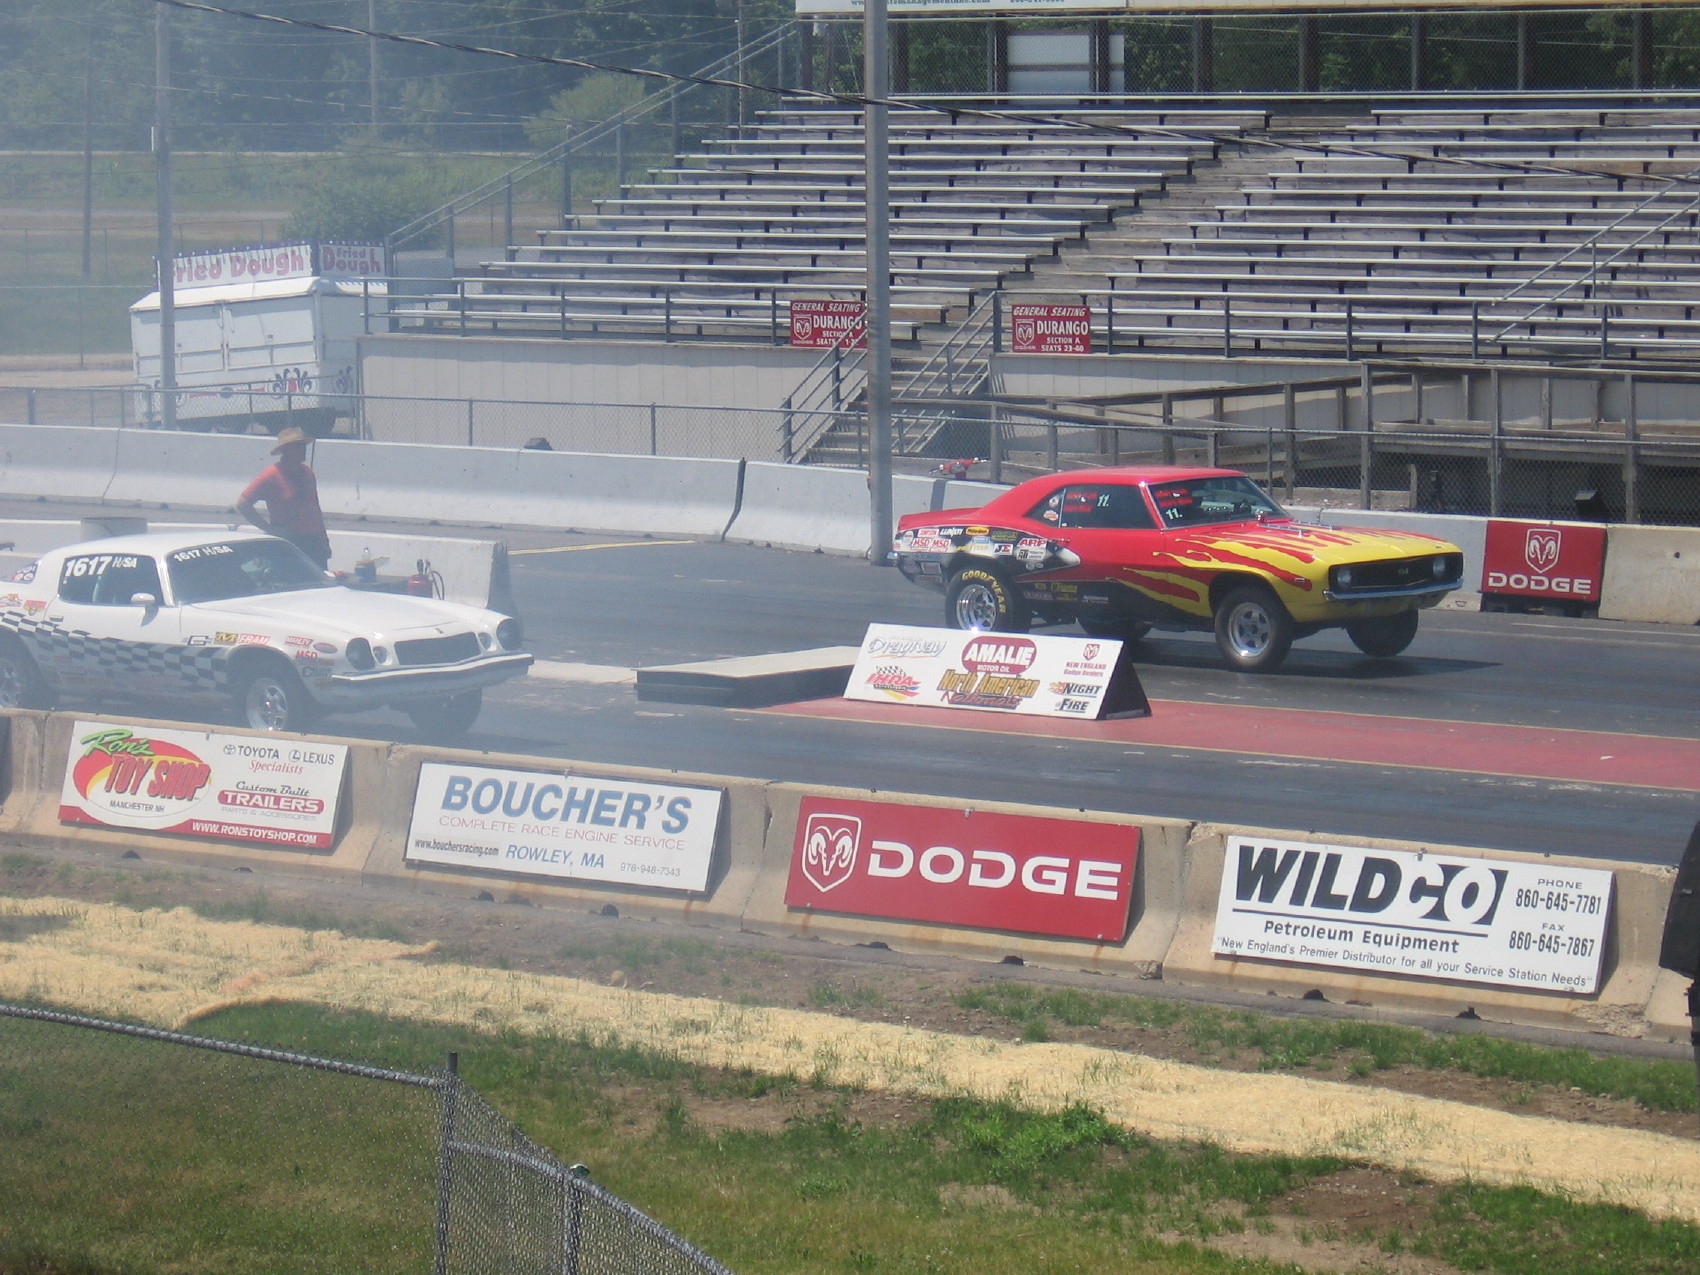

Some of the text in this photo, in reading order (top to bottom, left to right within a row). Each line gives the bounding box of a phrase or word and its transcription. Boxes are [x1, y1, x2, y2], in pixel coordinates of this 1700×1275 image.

[173, 250, 304, 283] ried Dough
[323, 247, 381, 274] Dough
[791, 302, 861, 312] GENERAL SEATING
[1013, 306, 1087, 317] GENERAL SEATING
[813, 315, 862, 330] DURANGO
[1036, 320, 1089, 335] DURANGO
[914, 539, 931, 547] MSD
[932, 539, 950, 548] MSD
[1017, 538, 1047, 547] ARP
[173, 545, 233, 562] 1617 H/SA
[65, 555, 138, 577] 1617 H/SA
[1488, 572, 1592, 595] DODGE
[239, 634, 269, 644] FRAM
[295, 651, 318, 660] MSD
[963, 643, 1035, 666] AMALIE
[977, 664, 999, 672] MOTOR
[865, 673, 915, 686] IHRA
[936, 669, 1040, 698] North American
[1063, 682, 1102, 694] NIGHT
[1059, 698, 1090, 711] FIRE
[80, 729, 154, 757] Ron's
[238, 745, 280, 759] TOYOTA
[303, 752, 336, 765] LEXUS
[249, 759, 304, 775] Specialists
[104, 754, 211, 801] TOY SHOP
[235, 780, 310, 797] Custom Built
[109, 800, 165, 813] MANCHESTER NH
[223, 791, 320, 813] TRAILERS
[441, 775, 693, 834] BOUCHER'S
[192, 821, 318, 845] WWW.RONSTOYSHOP.COM
[439, 815, 686, 851] COMPLETE RACE ENGINE SERVICE
[414, 838, 500, 858] www.bouchersracing.com
[505, 844, 606, 869] ROWLEY, MA
[619, 861, 681, 878] 978-948-7343
[868, 840, 1123, 901] DODGE
[1235, 844, 1510, 926] WILDCO
[1537, 878, 1584, 890] PHONE
[1515, 888, 1602, 915] 860-645-7781
[1542, 922, 1566, 932] FAX
[1264, 920, 1460, 953] Petroleum Equipment
[1509, 930, 1595, 957] 860-645-7867
[1247, 939, 1295, 955] England's
[1299, 945, 1339, 959] Premier
[1343, 950, 1397, 965] Distributor
[1401, 955, 1416, 967] for
[1420, 958, 1433, 969] all
[1436, 962, 1460, 975] your
[1464, 962, 1504, 977] Service
[1508, 967, 1548, 982] Station
